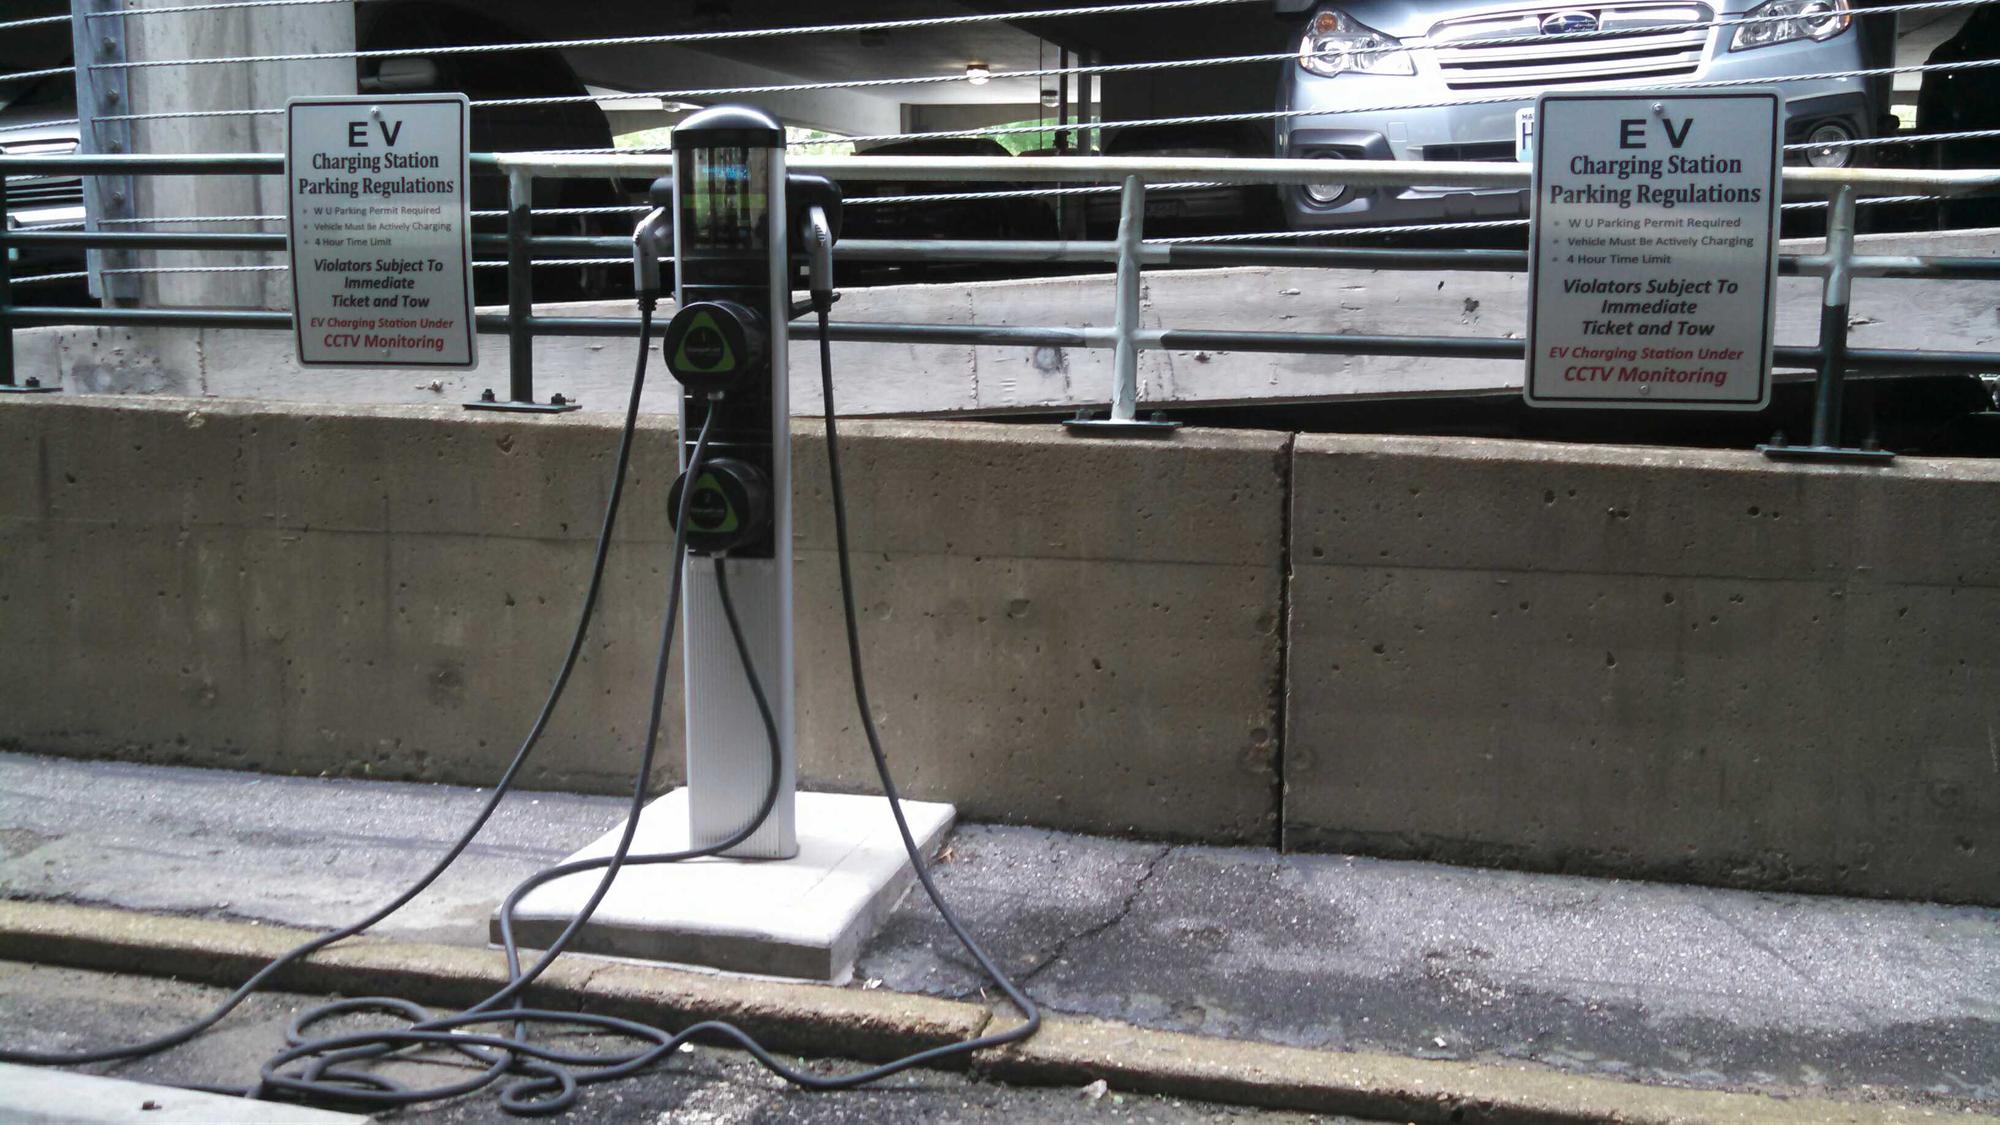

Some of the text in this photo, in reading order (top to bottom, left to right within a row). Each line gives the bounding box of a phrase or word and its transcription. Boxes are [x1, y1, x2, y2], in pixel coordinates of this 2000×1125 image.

[312, 153, 439, 173] Charging Station
[1570, 155, 1742, 179] Charging Station
[299, 177, 454, 198] Parking Regulations
[1550, 183, 1760, 208] Parking Regulations
[335, 207, 367, 216] Parking
[369, 206, 398, 215] Permit
[401, 206, 440, 216] Required
[314, 222, 452, 232] Vehicle Must Be Actively Charging
[1597, 218, 1640, 229] Parking
[1644, 218, 1683, 228] Permit
[1687, 218, 1741, 229] Required
[322, 238, 344, 246] Hour
[347, 238, 368, 246] Time
[370, 238, 392, 246] Limit
[1567, 236, 1754, 247] Vehicle Must Be Actively Charging
[1577, 255, 1606, 264] Hour
[1609, 255, 1638, 264] Time
[1641, 255, 1671, 264] Limit
[314, 259, 443, 275] Violators Subject To
[344, 277, 415, 289] Immediate
[1563, 279, 1738, 297] Violators Subject To
[332, 295, 430, 308] Ticket and Tow
[1601, 300, 1697, 314] Immediate
[310, 318, 453, 330] EV Charging Station Under
[1582, 321, 1715, 336] Ticket and Tow
[324, 335, 444, 351] CCTV Monitoring
[1549, 347, 1744, 362] EV Charging Station Under
[1564, 367, 1728, 387] CCTV Monitoring
